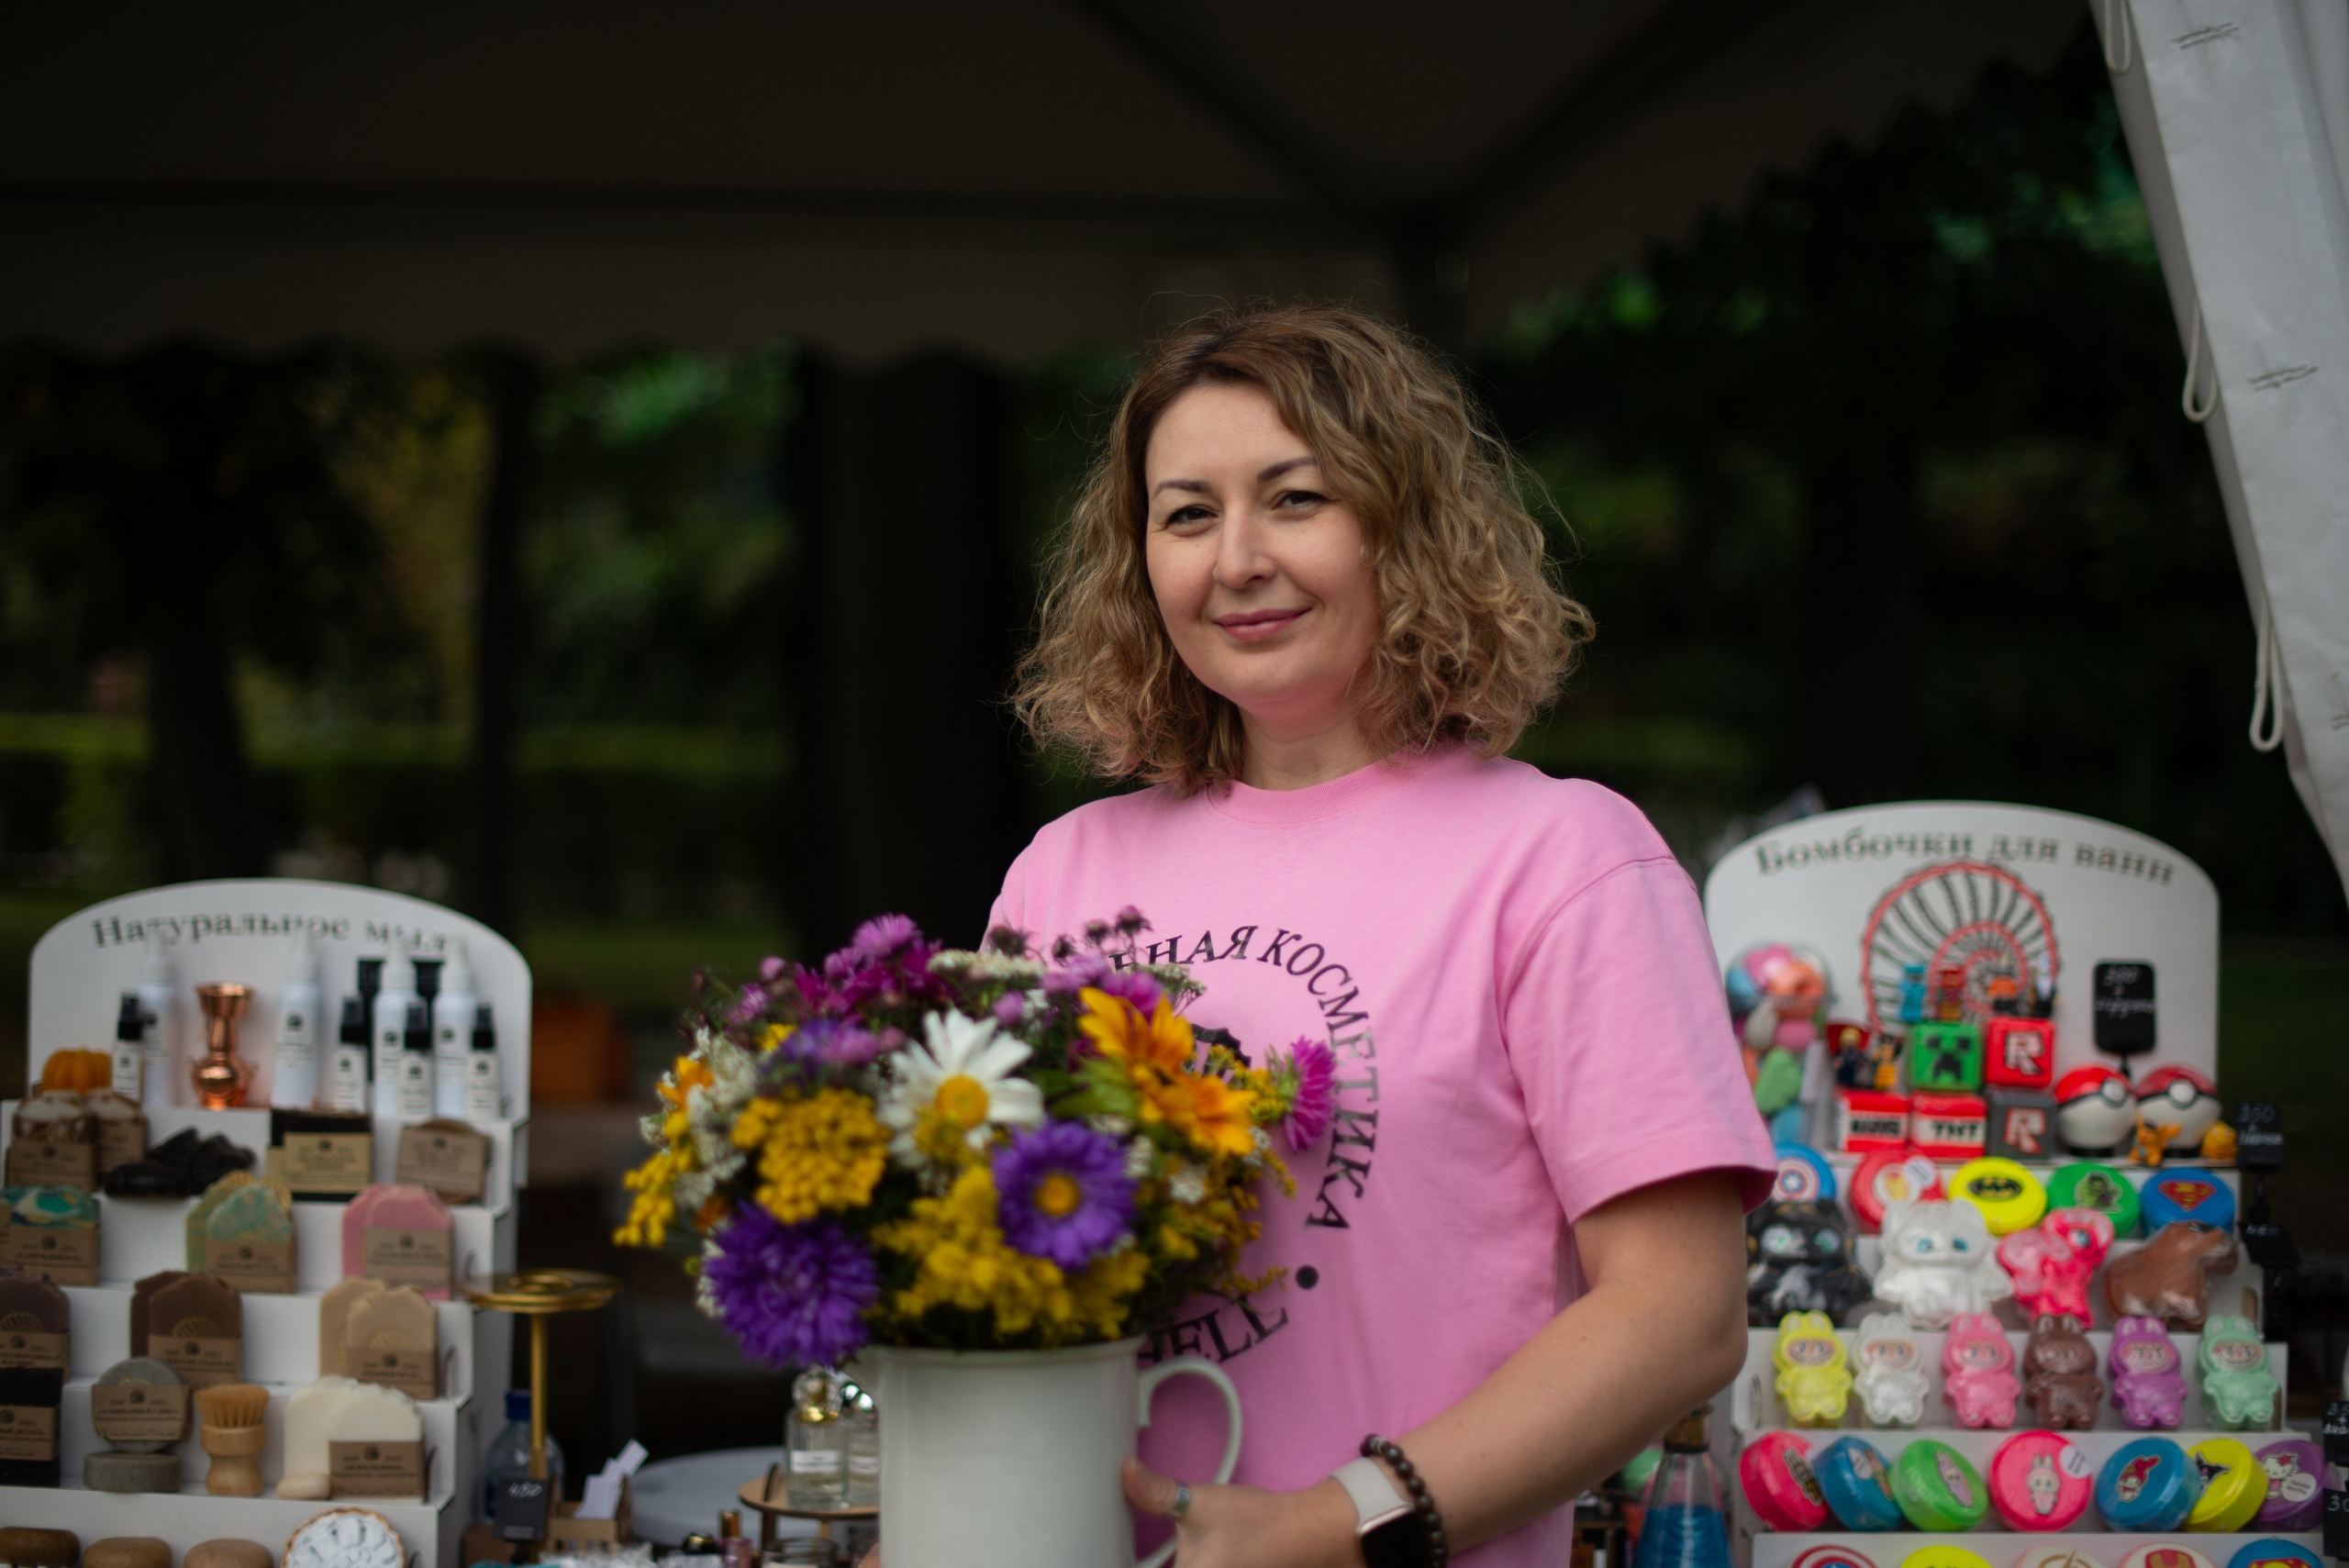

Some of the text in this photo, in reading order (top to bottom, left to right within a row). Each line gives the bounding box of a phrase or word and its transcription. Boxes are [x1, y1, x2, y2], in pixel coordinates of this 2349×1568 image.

[1756, 828, 2174, 885] Бомбочки для ванн
[1256, 928, 1380, 1229] КОСМЕТИКА
[2004, 1030, 2043, 1076] R
[2004, 1106, 2045, 1154] R
